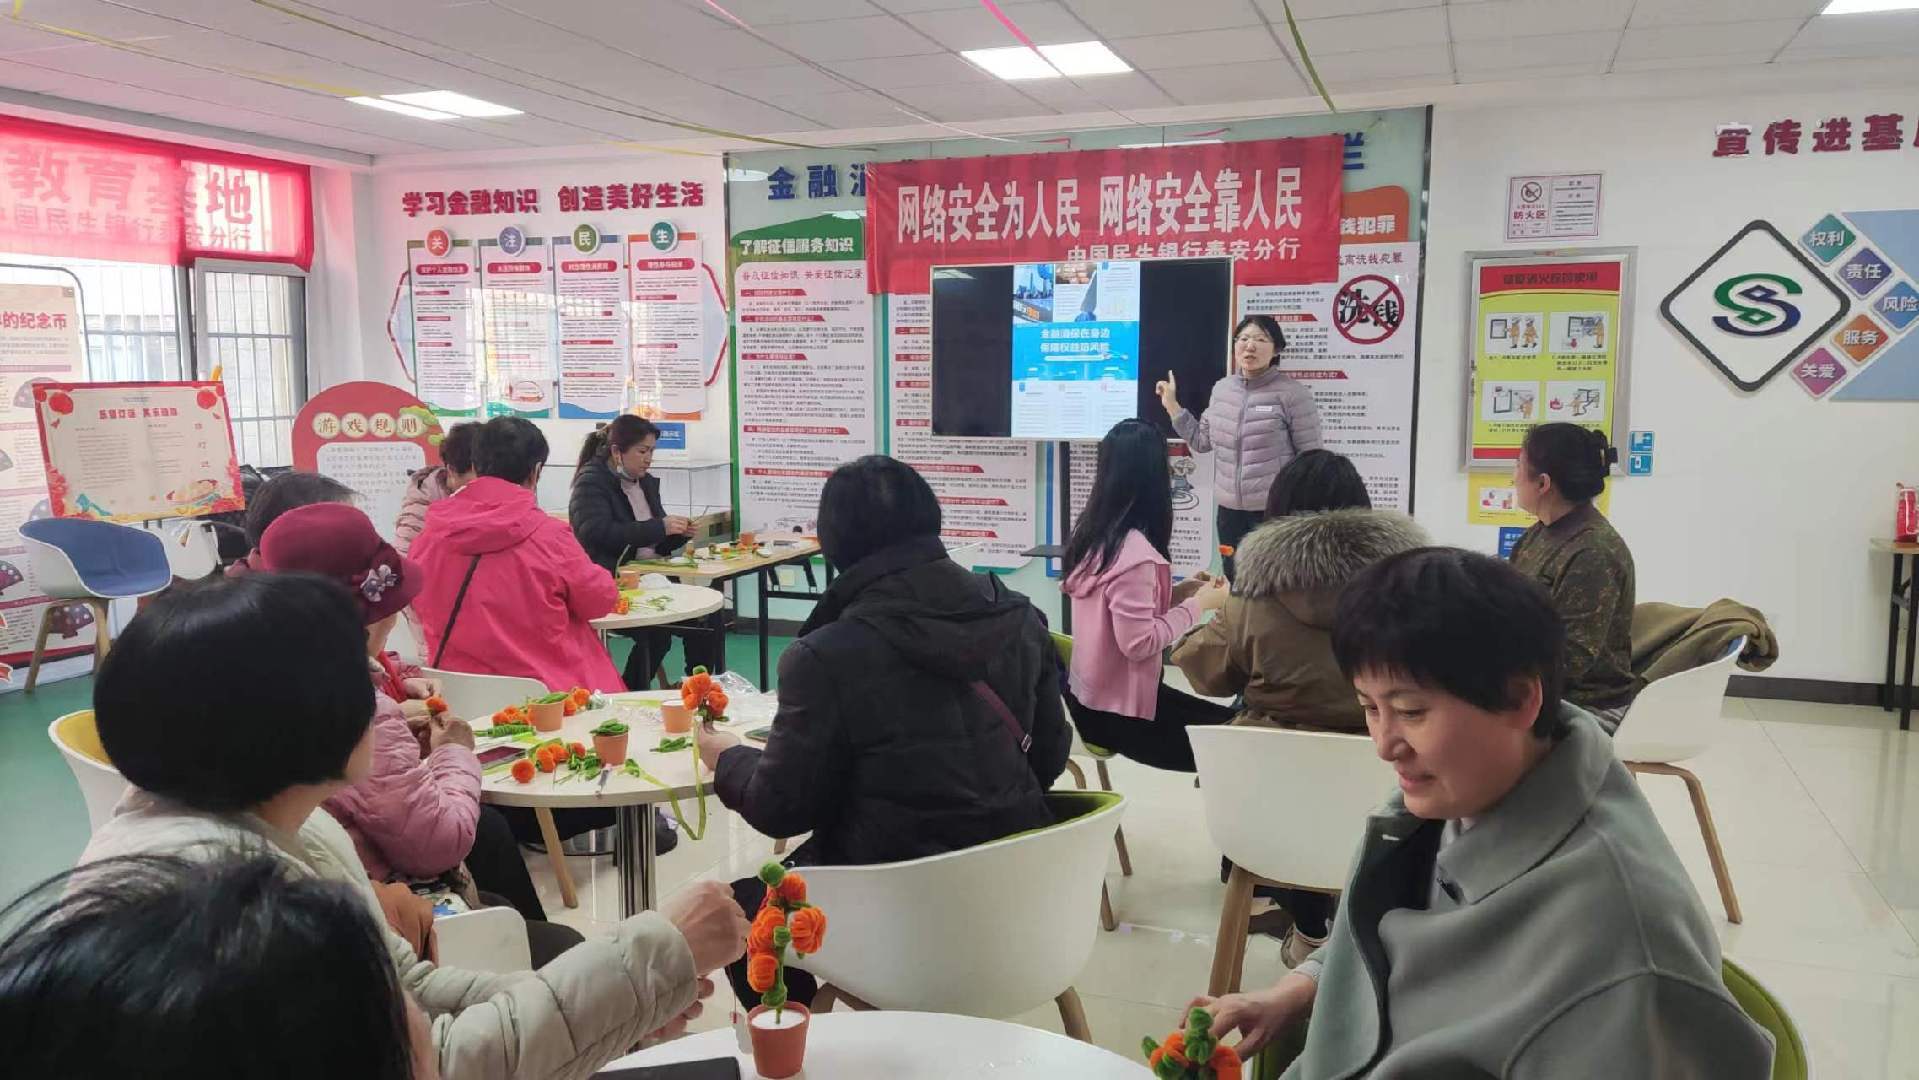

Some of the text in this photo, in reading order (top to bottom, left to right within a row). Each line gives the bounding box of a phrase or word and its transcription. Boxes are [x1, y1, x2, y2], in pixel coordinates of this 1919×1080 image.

[1713, 113, 1919, 157] 宣传进基
[402, 181, 704, 217] 学习金融知识 创造美好生活
[898, 168, 1302, 244] 网络安全为人民 网络安全靠人民
[1513, 210, 1546, 220] 防火区
[431, 229, 669, 250] 关 注 民 生
[740, 237, 854, 256] 了解征信服务知识
[1810, 230, 1845, 247] 权利
[1846, 263, 1883, 280] 责任
[1338, 289, 1400, 328] 洗钱
[1883, 296, 1919, 313] 风险
[0, 311, 67, 331] 的纪念币
[1843, 330, 1879, 345] 服务
[1801, 363, 1836, 379] 关爱
[319, 417, 418, 434] 游戏规则
